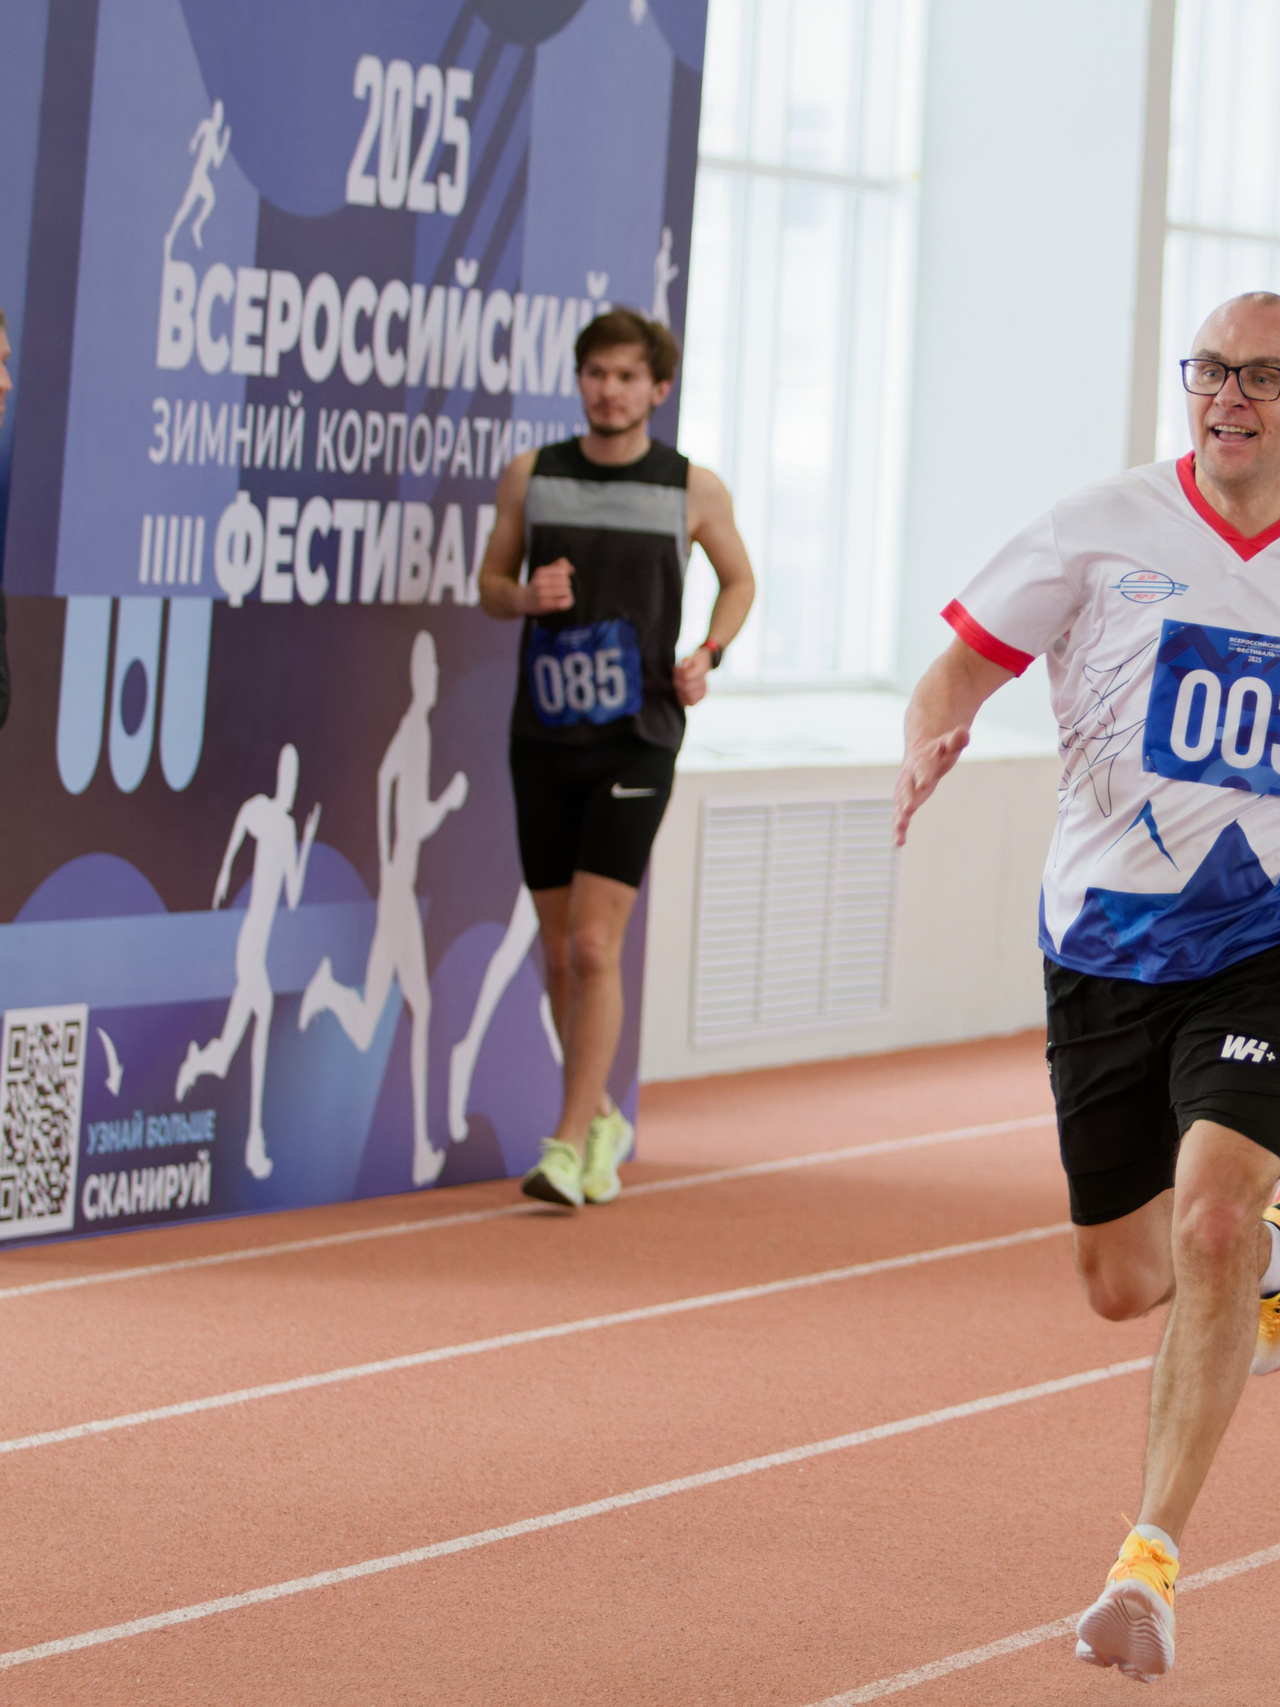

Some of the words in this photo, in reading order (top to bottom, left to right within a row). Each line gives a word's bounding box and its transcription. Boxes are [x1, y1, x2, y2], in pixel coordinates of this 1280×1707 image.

[346, 54, 473, 217] 2025
[148, 390, 306, 472] ЗИМНИЙ
[316, 406, 590, 481] КОРПОРАТИВ
[213, 490, 497, 609] ФЕСТИВА
[533, 647, 627, 715] 085
[1236, 647, 1276, 658] ФЕСТИВАЛЬ
[1247, 655, 1262, 663] 2025
[86, 1109, 144, 1156] УЗНАЙ
[145, 1109, 216, 1149] БОЛЬШЕ
[82, 1149, 211, 1221] СКАНИРУЙ
